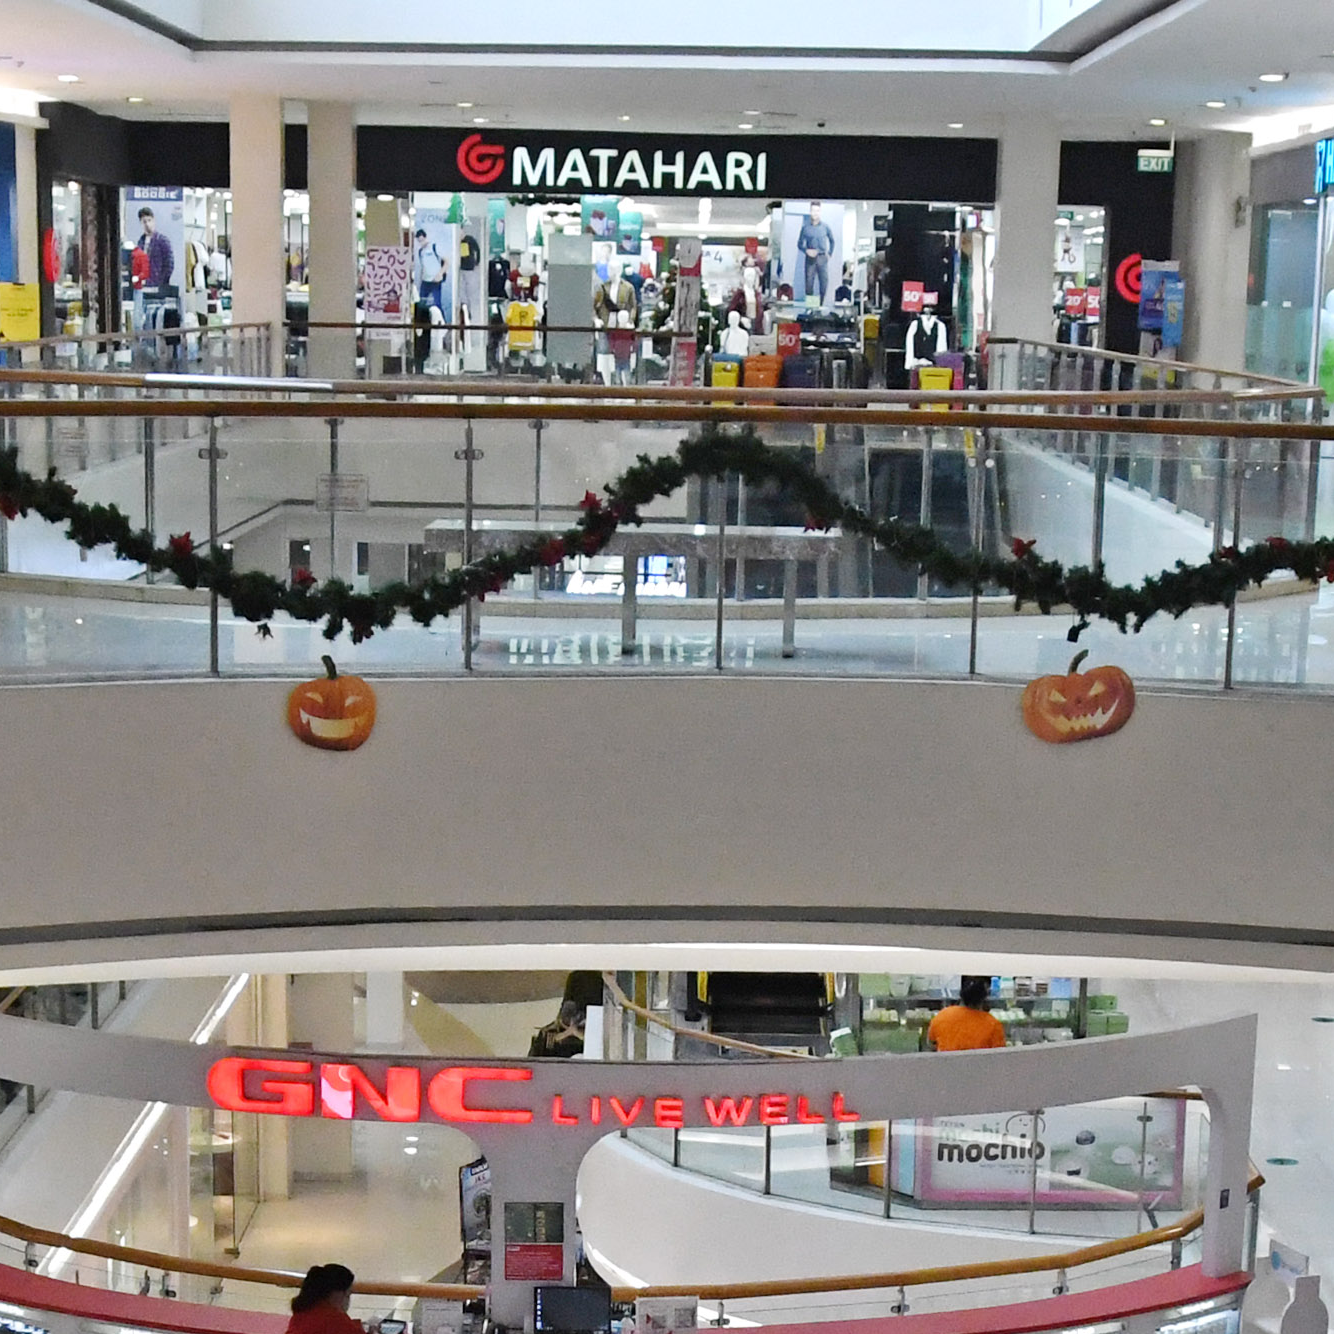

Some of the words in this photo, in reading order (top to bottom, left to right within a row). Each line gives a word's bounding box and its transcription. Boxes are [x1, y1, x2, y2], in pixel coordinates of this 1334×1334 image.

[512, 146, 767, 191] MATAHARI
[1139, 157, 1172, 172] EXIT
[206, 1057, 534, 1124] GNC
[552, 1093, 684, 1129] LIVE
[703, 1091, 861, 1127] WELL
